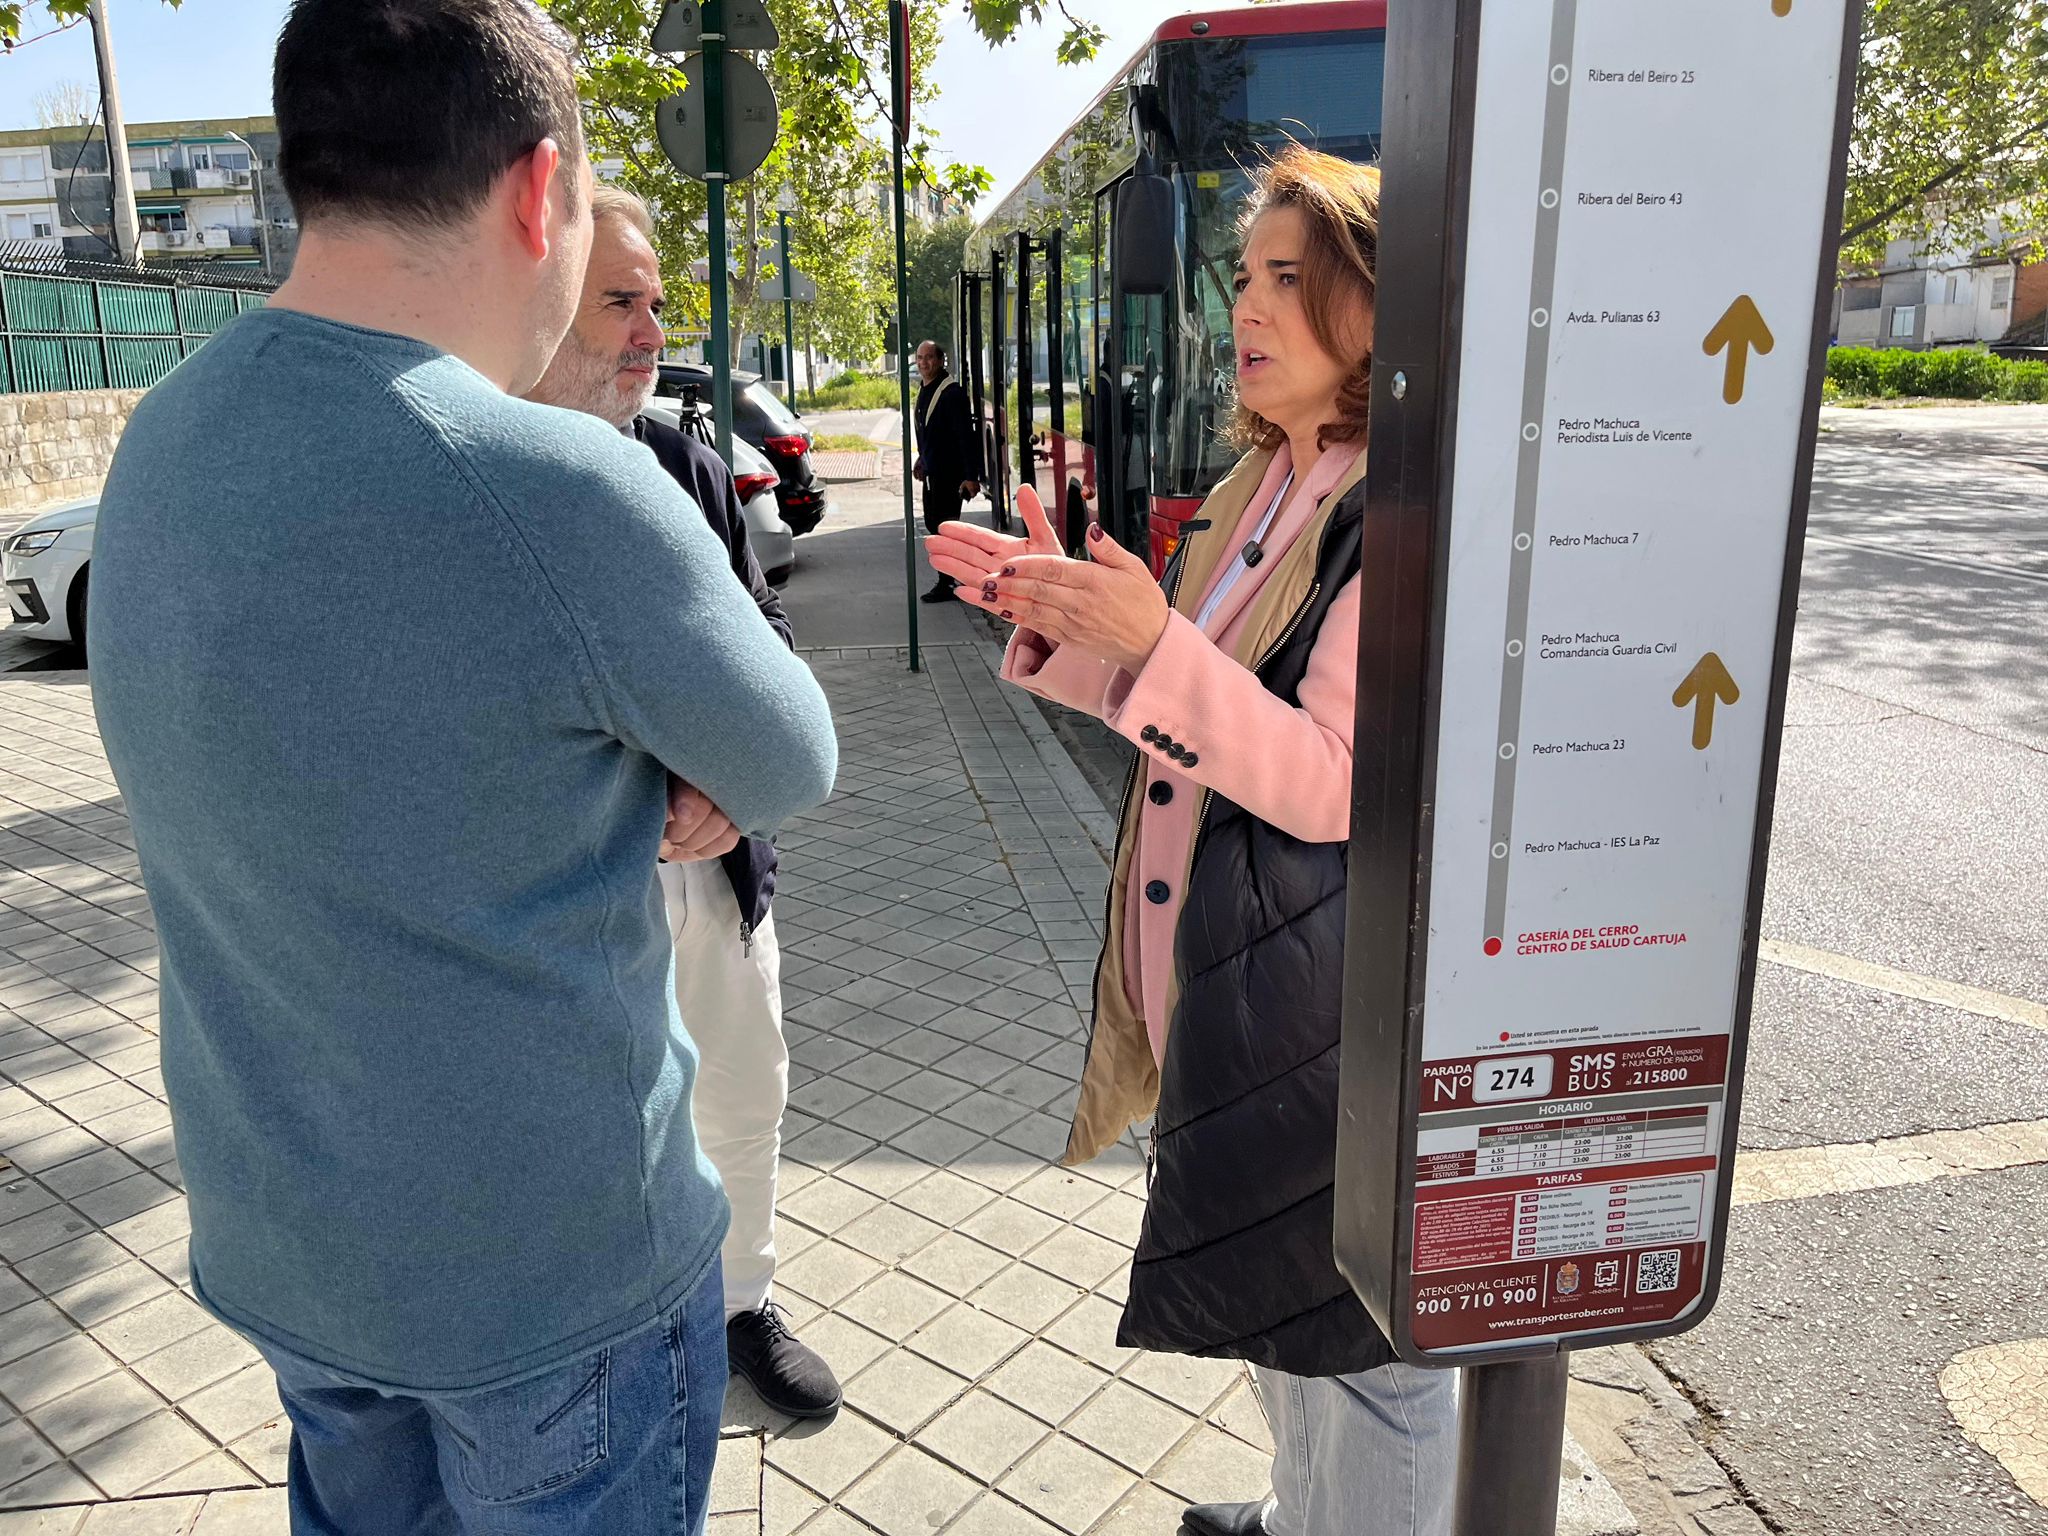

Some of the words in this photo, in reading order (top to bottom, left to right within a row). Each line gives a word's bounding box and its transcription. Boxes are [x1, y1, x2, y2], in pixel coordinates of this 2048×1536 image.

[1588, 69, 1624, 82] Ribera
[1627, 70, 1644, 82] del
[1648, 70, 1677, 83] Beiro
[1681, 71, 1695, 83] 25
[1577, 192, 1613, 205] Ribera
[1616, 193, 1633, 205] del
[1636, 193, 1666, 205] Beiro
[1669, 192, 1683, 205] 43
[1567, 312, 1597, 323] Avda.
[1601, 311, 1643, 323] Pulianas
[1646, 311, 1661, 322] 63
[1558, 418, 1590, 430] Pedro
[1593, 418, 1640, 429] Machuca
[1557, 432, 1609, 443] Periodista
[1612, 431, 1633, 442] Luis
[1636, 431, 1649, 442] de
[1652, 430, 1692, 440] Vicente
[1549, 535, 1581, 546] Pedro
[1583, 534, 1629, 545] Machuca
[1632, 532, 1639, 544] 7
[1541, 634, 1572, 645] Pedro
[1575, 632, 1620, 644] Machuca
[1540, 646, 1609, 659] Comandancia
[1612, 644, 1652, 656] Guardia
[1655, 642, 1677, 654] Civil
[1532, 744, 1563, 754] Pedro
[1566, 742, 1610, 752] Machuca
[1613, 739, 1625, 750] 23
[1525, 843, 1555, 853] Pedro
[1558, 840, 1601, 851] Machuca
[1611, 837, 1626, 848] IES
[1629, 836, 1640, 847] La
[1643, 835, 1660, 846] Paz
[1518, 928, 1565, 944] CASERÍA
[1573, 929, 1595, 939] DEL
[1598, 924, 1639, 937] CERRO
[1517, 942, 1567, 956] CENTRO
[1570, 941, 1587, 951] DE
[1590, 937, 1630, 950] SALUD
[1633, 933, 1687, 946] CARTUJA
[1580, 1025, 1599, 1033] parada
[1646, 1045, 1674, 1058] GRA
[1673, 1047, 1703, 1057] (espacio)
[1675, 1054, 1703, 1063] PARADA
[1569, 1052, 1616, 1073] SMS
[1423, 1064, 1472, 1077] PARADA
[1633, 1067, 1688, 1085] 215800
[1490, 1067, 1534, 1091] 274
[1568, 1071, 1612, 1092] BUS
[1538, 1102, 1593, 1116] HORARIO
[1584, 1116, 1605, 1125] ÚLTIMA
[1606, 1115, 1627, 1123] SALIDA
[1497, 1125, 1523, 1133] PRIMERA
[1524, 1123, 1544, 1131] SALIDA
[1428, 1153, 1465, 1162] LABORABLES
[1432, 1171, 1459, 1179] FESTIVOS
[1536, 1172, 1582, 1186] TARIFAS
[1417, 1281, 1475, 1298] ATENCIÓN
[1477, 1281, 1491, 1290] AL
[1493, 1274, 1537, 1289] CLIENTE
[1416, 1298, 1451, 1315] 900
[1460, 1292, 1494, 1310] 710
[1503, 1288, 1537, 1304] 900
[1488, 1306, 1624, 1329] www.transportesrober.com
